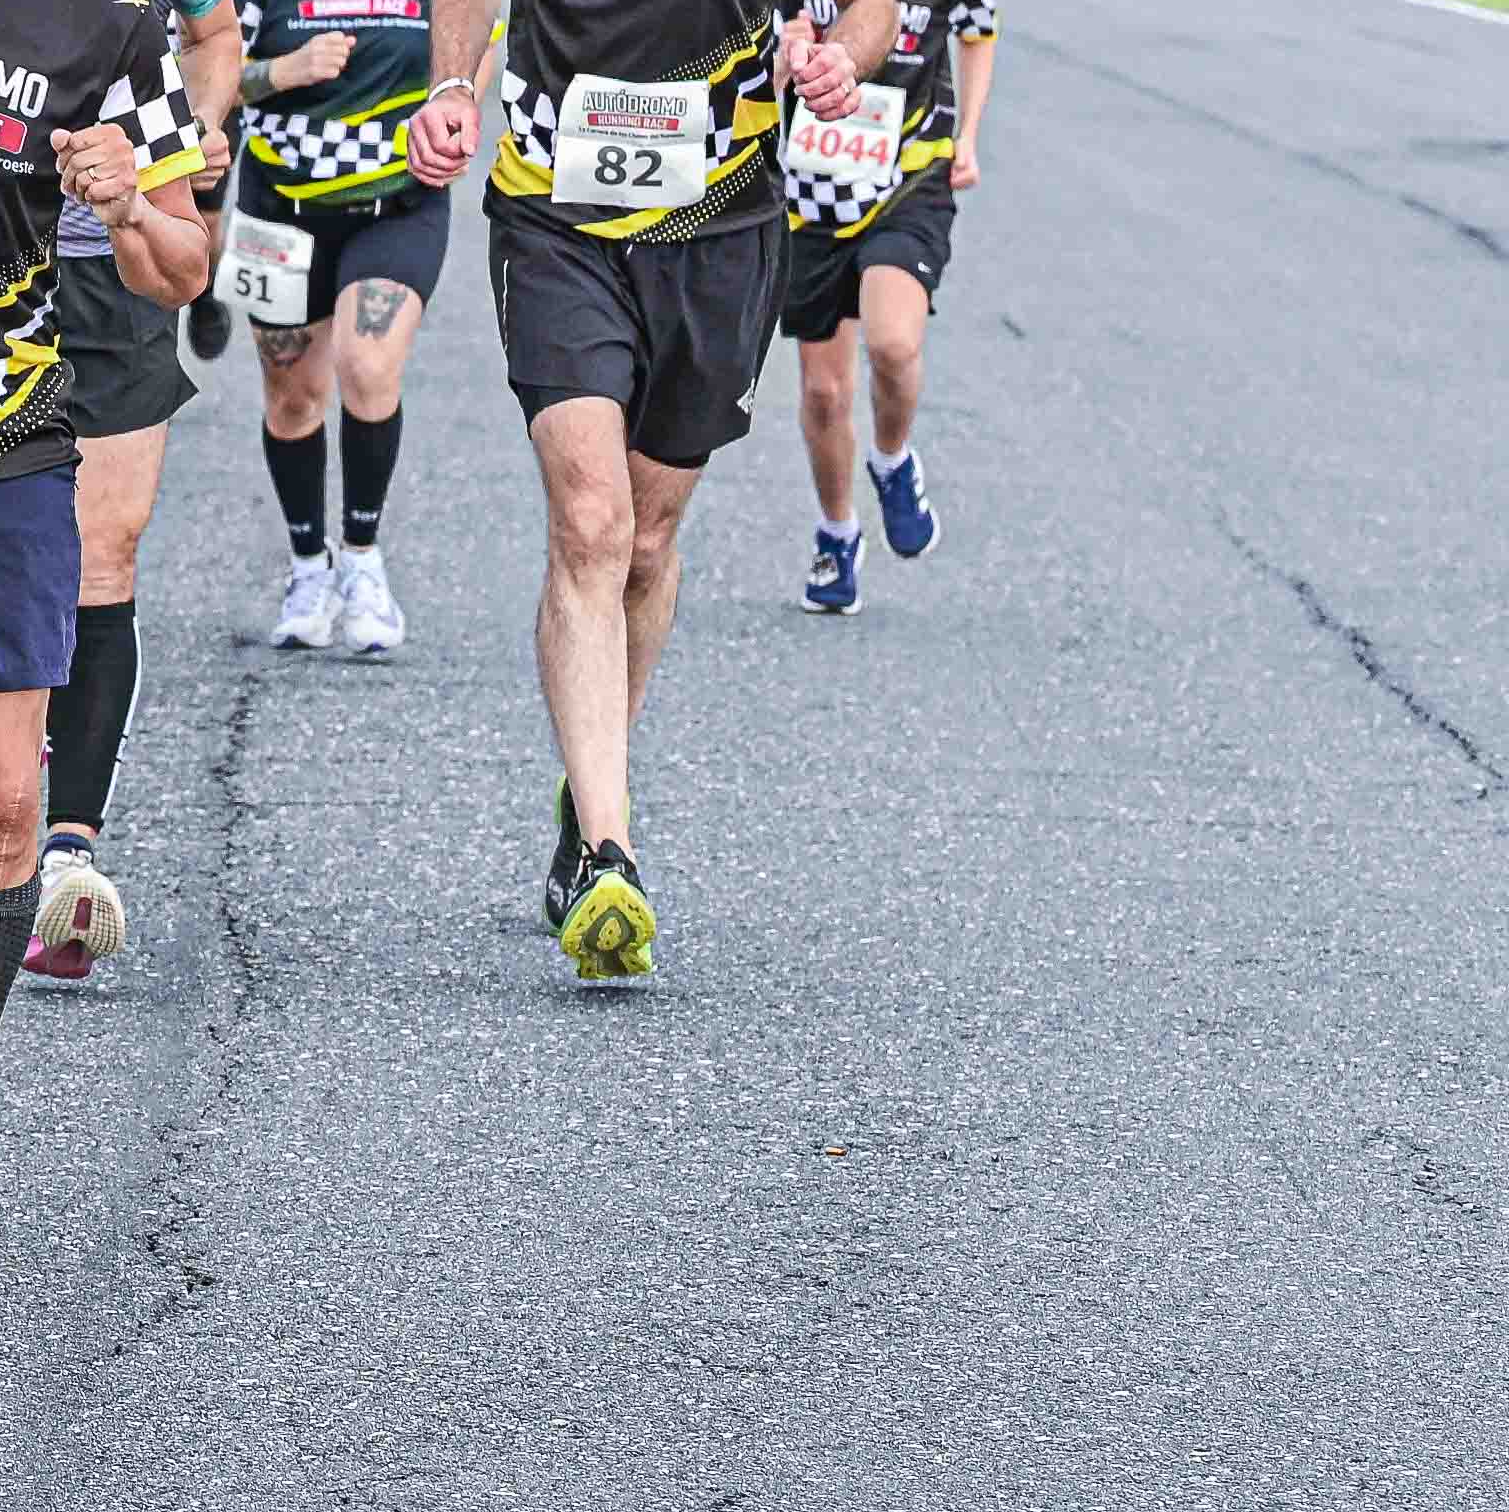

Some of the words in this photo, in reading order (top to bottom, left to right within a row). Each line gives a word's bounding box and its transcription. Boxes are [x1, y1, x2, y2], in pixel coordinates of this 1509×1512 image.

[582, 88, 687, 116] AUTÓDROMO
[793, 123, 889, 166] 4044
[594, 145, 663, 187] 82
[236, 269, 273, 304] 51
